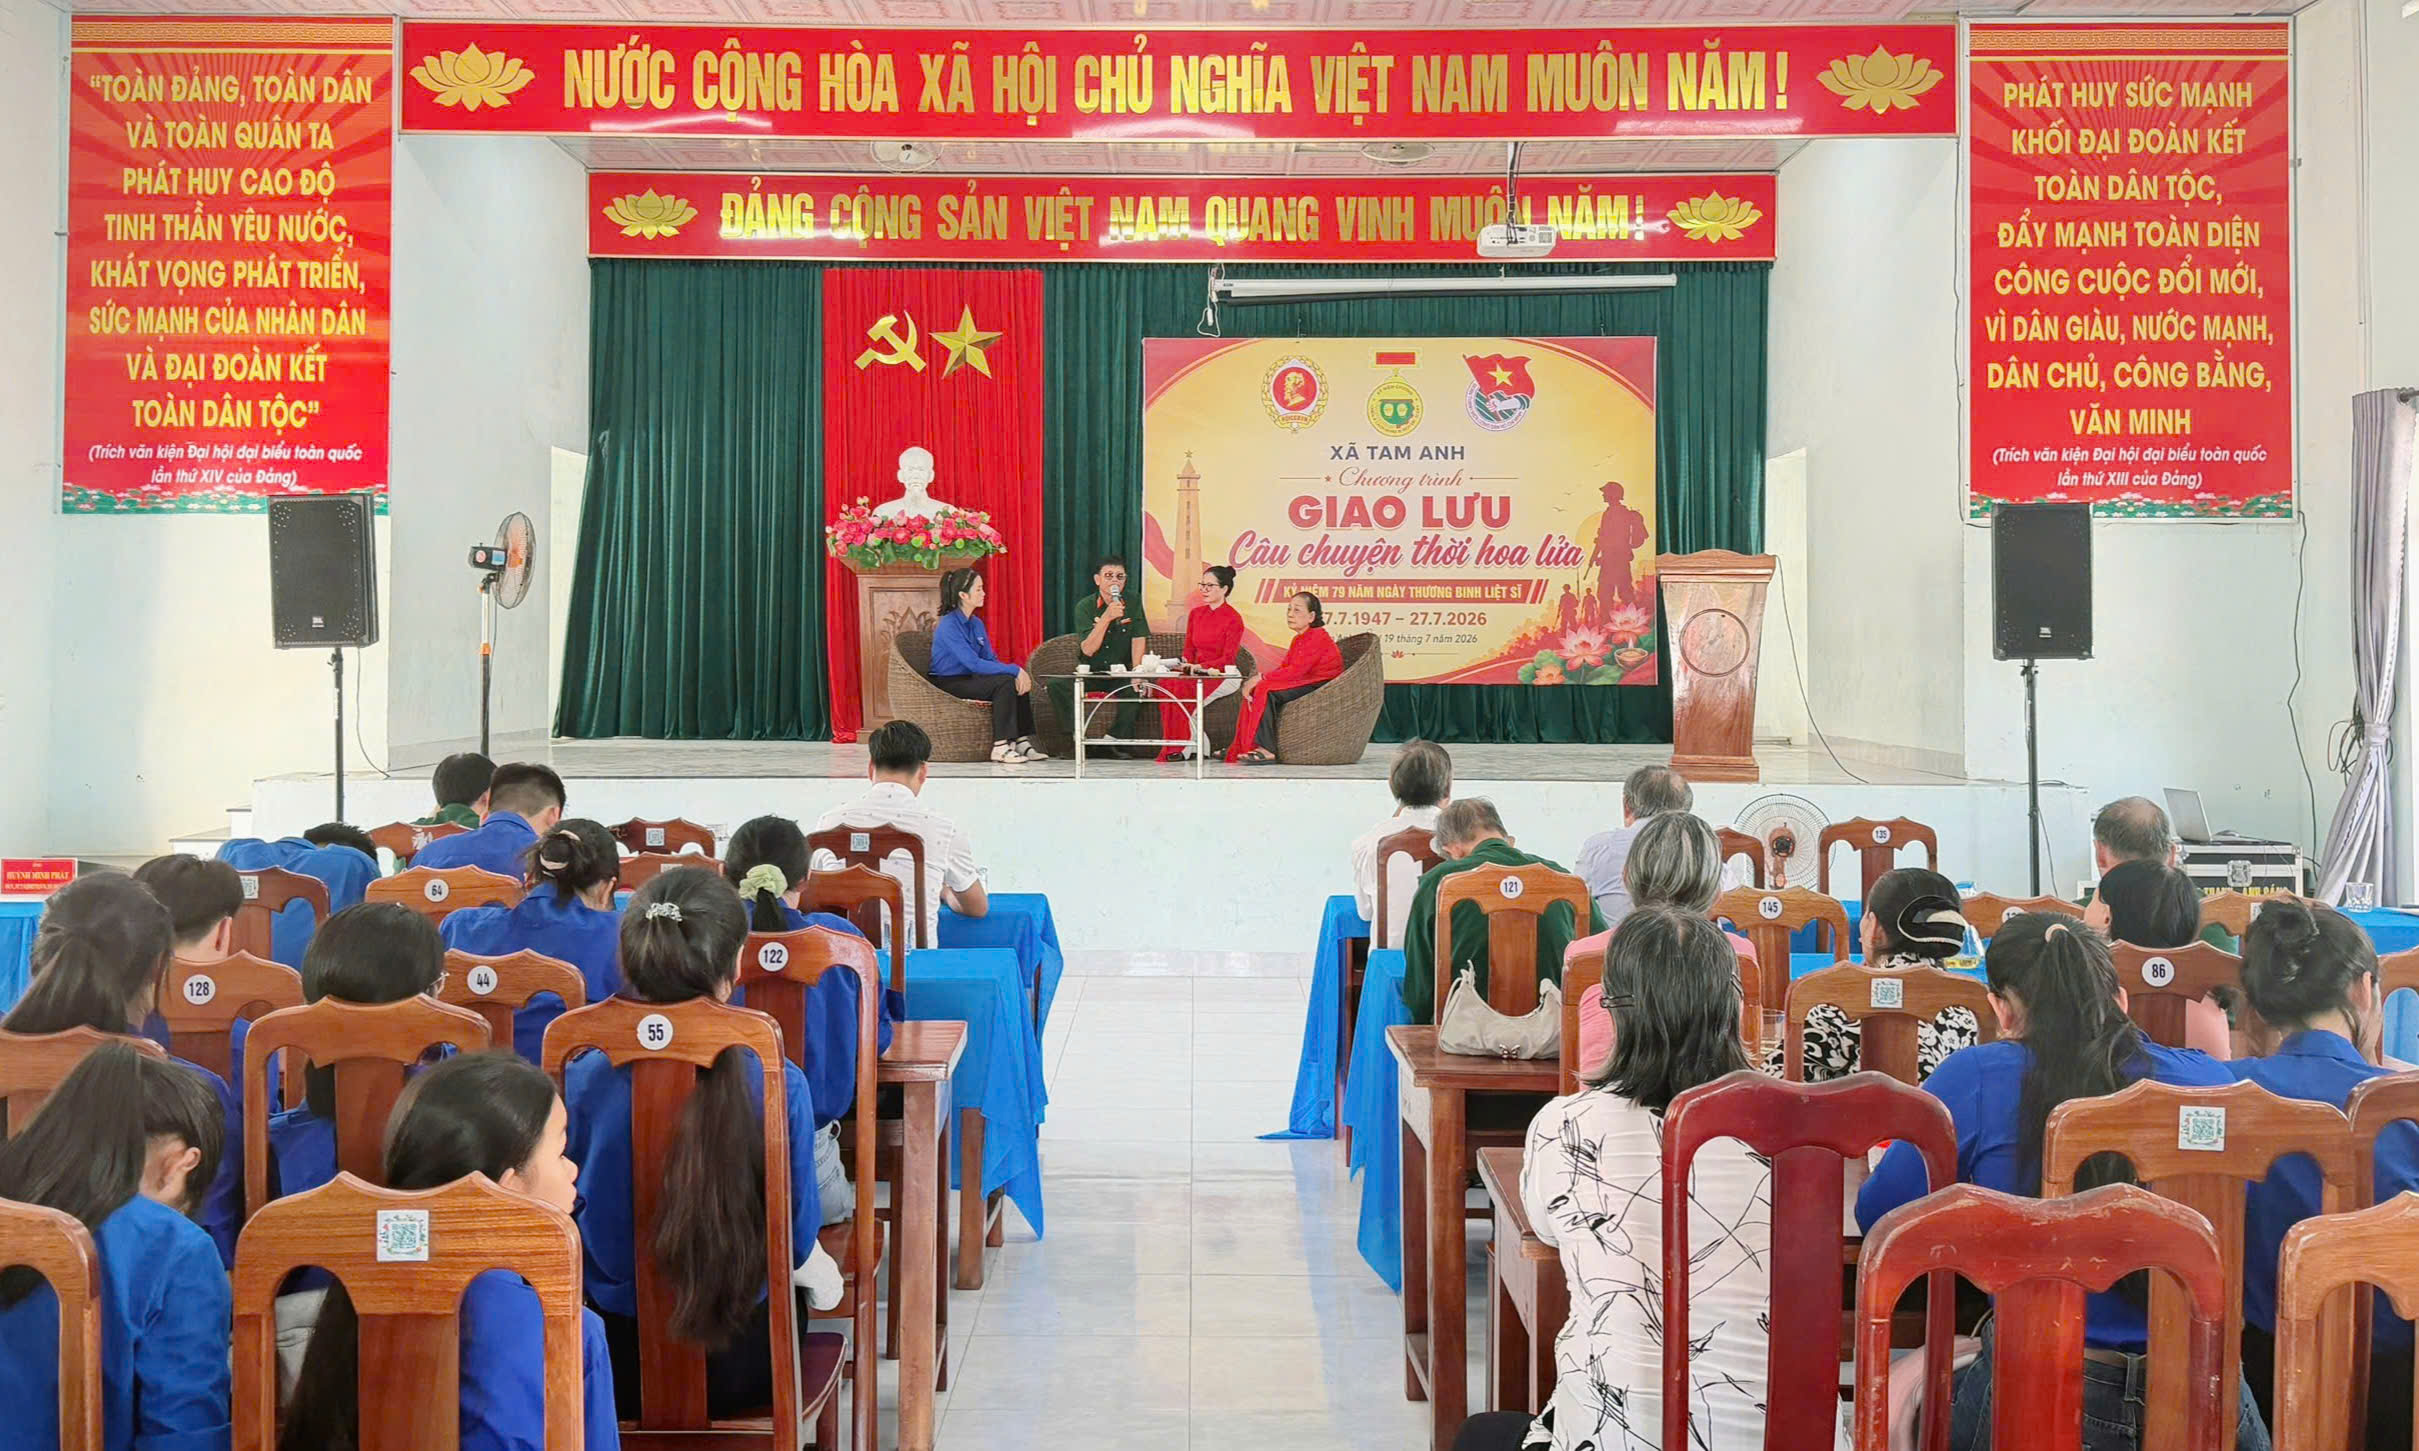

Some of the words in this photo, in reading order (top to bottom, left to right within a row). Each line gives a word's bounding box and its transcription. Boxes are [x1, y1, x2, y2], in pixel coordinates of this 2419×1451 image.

[91, 68, 163, 102] “TOÀN
[172, 66, 245, 107] ĐẢNG,
[253, 68, 315, 103] TOÀN
[323, 69, 372, 103] DÂN
[565, 35, 675, 109] NƯỚC
[690, 38, 801, 126] CỘNG
[820, 40, 898, 112] HÒA
[919, 42, 974, 112] XÃ
[993, 42, 1056, 126] HỘI
[1075, 34, 1154, 114] CHỦ
[1171, 42, 1292, 114] NGHĨA
[1311, 42, 1394, 125] VIỆT
[1413, 55, 1507, 112] NAM
[1528, 40, 1648, 112] MUÔN
[2004, 75, 2064, 107] PHÁT
[2072, 82, 2118, 107] HUY
[2126, 75, 2172, 107] SỨC
[2181, 82, 2252, 114] MẠNH
[127, 114, 157, 148] VÀ
[165, 114, 227, 148] TOÀN
[235, 114, 301, 149] QUÂN
[308, 122, 334, 149] TA
[2013, 118, 2070, 154] KHỐI
[2079, 129, 2119, 160] ĐẠI
[2128, 121, 2198, 154] ĐOÀN
[2208, 118, 2245, 153] KẾT
[124, 160, 181, 194] PHÁT
[188, 168, 233, 194] HUY
[240, 168, 292, 195] CAO
[299, 162, 335, 203] ĐỘ
[2035, 169, 2099, 200] TOÀN
[2108, 168, 2158, 200] DÂN
[2166, 168, 2221, 207] TỘC,
[105, 214, 155, 240] TINH
[163, 201, 222, 240] THẦN
[231, 208, 270, 241] YÊU
[279, 208, 352, 252] NƯỚC,
[720, 176, 815, 239] ĐẢNG
[830, 184, 921, 249] CỘNG
[937, 179, 1008, 240] SẢN
[1024, 186, 1095, 251] VIỆT
[1105, 196, 1194, 246] NAM
[1201, 196, 1318, 248] QUANG
[1336, 197, 1413, 241] VINH
[1998, 208, 2046, 247] ĐẨY
[2056, 222, 2126, 254] MẠNH
[2134, 215, 2198, 247] TOÀN
[2208, 215, 2259, 254] DIỆN
[92, 253, 150, 287] KHÁT
[157, 260, 226, 295] VỌNG
[234, 253, 292, 288] PHÁT
[297, 246, 364, 294] TRIỂN,
[1995, 262, 2069, 294] CÔNG
[2078, 262, 2150, 300] CUỘC
[2158, 254, 2201, 294] ĐỔI
[2211, 261, 2263, 298] MỚI,
[89, 299, 130, 334] SỨC
[137, 307, 198, 341] MẠNH
[205, 297, 250, 336] CỦA
[256, 300, 315, 336] NHÂN
[321, 301, 367, 336] DÂN
[1986, 309, 2005, 341] VÌ
[2014, 309, 2058, 341] DÂN
[2066, 309, 2125, 344] GIÀU,
[2133, 308, 2195, 340] NƯỚC
[2204, 316, 2272, 347] MẠNH,
[126, 346, 158, 380] VÀ
[165, 354, 205, 388] ĐẠI
[213, 346, 281, 381] ĐOÀN
[290, 343, 328, 381] KẾT
[1988, 356, 2038, 388] DÂN
[2048, 353, 2105, 392] CHỦ,
[2114, 355, 2188, 387] CÔNG
[2197, 350, 2271, 392] BẰNG,
[133, 392, 195, 427] TOÀN
[203, 392, 251, 427] DÂN
[259, 392, 319, 435] TỘC”
[2070, 403, 2120, 434] VĂN
[2129, 409, 2190, 434] MINH
[89, 444, 125, 461] (Trích
[130, 445, 152, 458] văn
[157, 444, 184, 462] kiện
[188, 445, 210, 462] Đại
[212, 444, 234, 462] hội
[236, 445, 259, 463] đại
[261, 441, 291, 459] biểu
[294, 445, 324, 459] toàn
[328, 444, 362, 462] quốc
[1330, 442, 1360, 460] XÃ
[1366, 446, 1411, 460] TAM
[1419, 446, 1465, 460] ANH
[1993, 448, 2029, 464] (Trích
[2034, 448, 2057, 461] văn
[2062, 447, 2088, 464] kiện
[2093, 448, 2115, 461] Đại
[2119, 447, 2139, 464] hội
[2143, 448, 2164, 464] đại
[2168, 443, 2196, 461] biểu
[2201, 447, 2229, 461] toàn
[2234, 445, 2266, 464] quốc
[152, 466, 172, 483] lần
[176, 468, 198, 483] thứ
[199, 468, 225, 484] XIV
[226, 468, 252, 484] của
[255, 467, 298, 487] Đảng)
[1338, 466, 1415, 494] Chương
[1418, 468, 1464, 487] trình
[2058, 468, 2078, 486] lần
[2083, 471, 2104, 485] thứ
[2106, 472, 2129, 485] XIII
[2133, 470, 2157, 485] của
[2162, 470, 2202, 489] Đảng)
[1287, 495, 1407, 530] GIAO
[1422, 492, 1512, 530] LƯU
[1228, 529, 1292, 569] Câu
[1297, 533, 1402, 578] chuyện
[1410, 533, 1470, 567] thời
[1474, 533, 1530, 567] hoa
[1535, 533, 1585, 567] lửa
[1332, 586, 1345, 598] 79
[1348, 584, 1373, 598] NĂM
[1377, 584, 1405, 598] NGÀY
[1408, 584, 1452, 598] THƯƠNG
[1455, 586, 1481, 598] BINH
[1484, 584, 1507, 600] LIỆT
[1510, 584, 1522, 598] SĨ
[1324, 612, 1391, 625] 7.7.1947
[1409, 612, 1487, 626] 27.7.2026
[1384, 634, 1395, 643] 19
[1396, 632, 1422, 645] tháng
[1424, 634, 1431, 643] 7
[1433, 633, 1453, 643] năm
[1455, 634, 1478, 643] 2026
[430, 884, 442, 896] 64
[1504, 881, 1518, 893] 121
[1763, 901, 1779, 913] 145
[764, 949, 783, 964] 122
[2152, 963, 2166, 978] 86
[188, 981, 210, 997] 128
[476, 974, 490, 987] 44
[648, 1024, 664, 1041] 55
